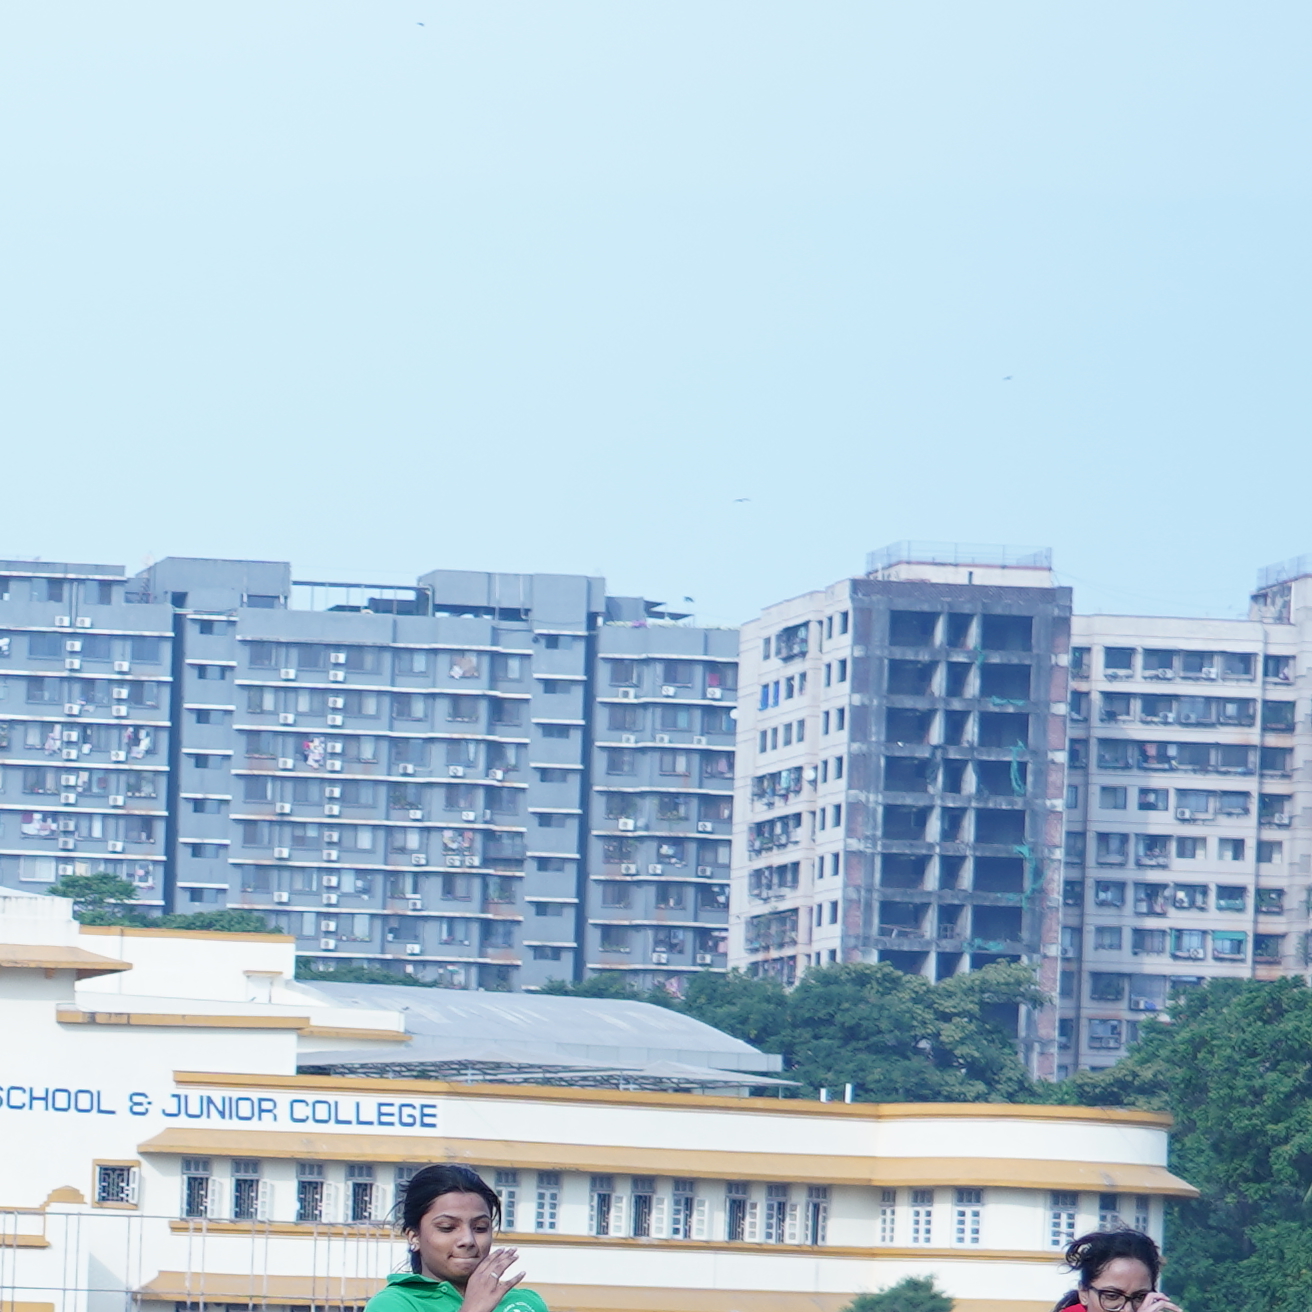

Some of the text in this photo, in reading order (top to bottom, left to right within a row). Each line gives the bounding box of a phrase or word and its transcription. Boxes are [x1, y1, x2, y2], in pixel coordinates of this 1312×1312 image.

[128, 1092, 152, 1116] &
[161, 1094, 277, 1121] JUNIOR
[289, 1099, 436, 1128] COLLEGE
